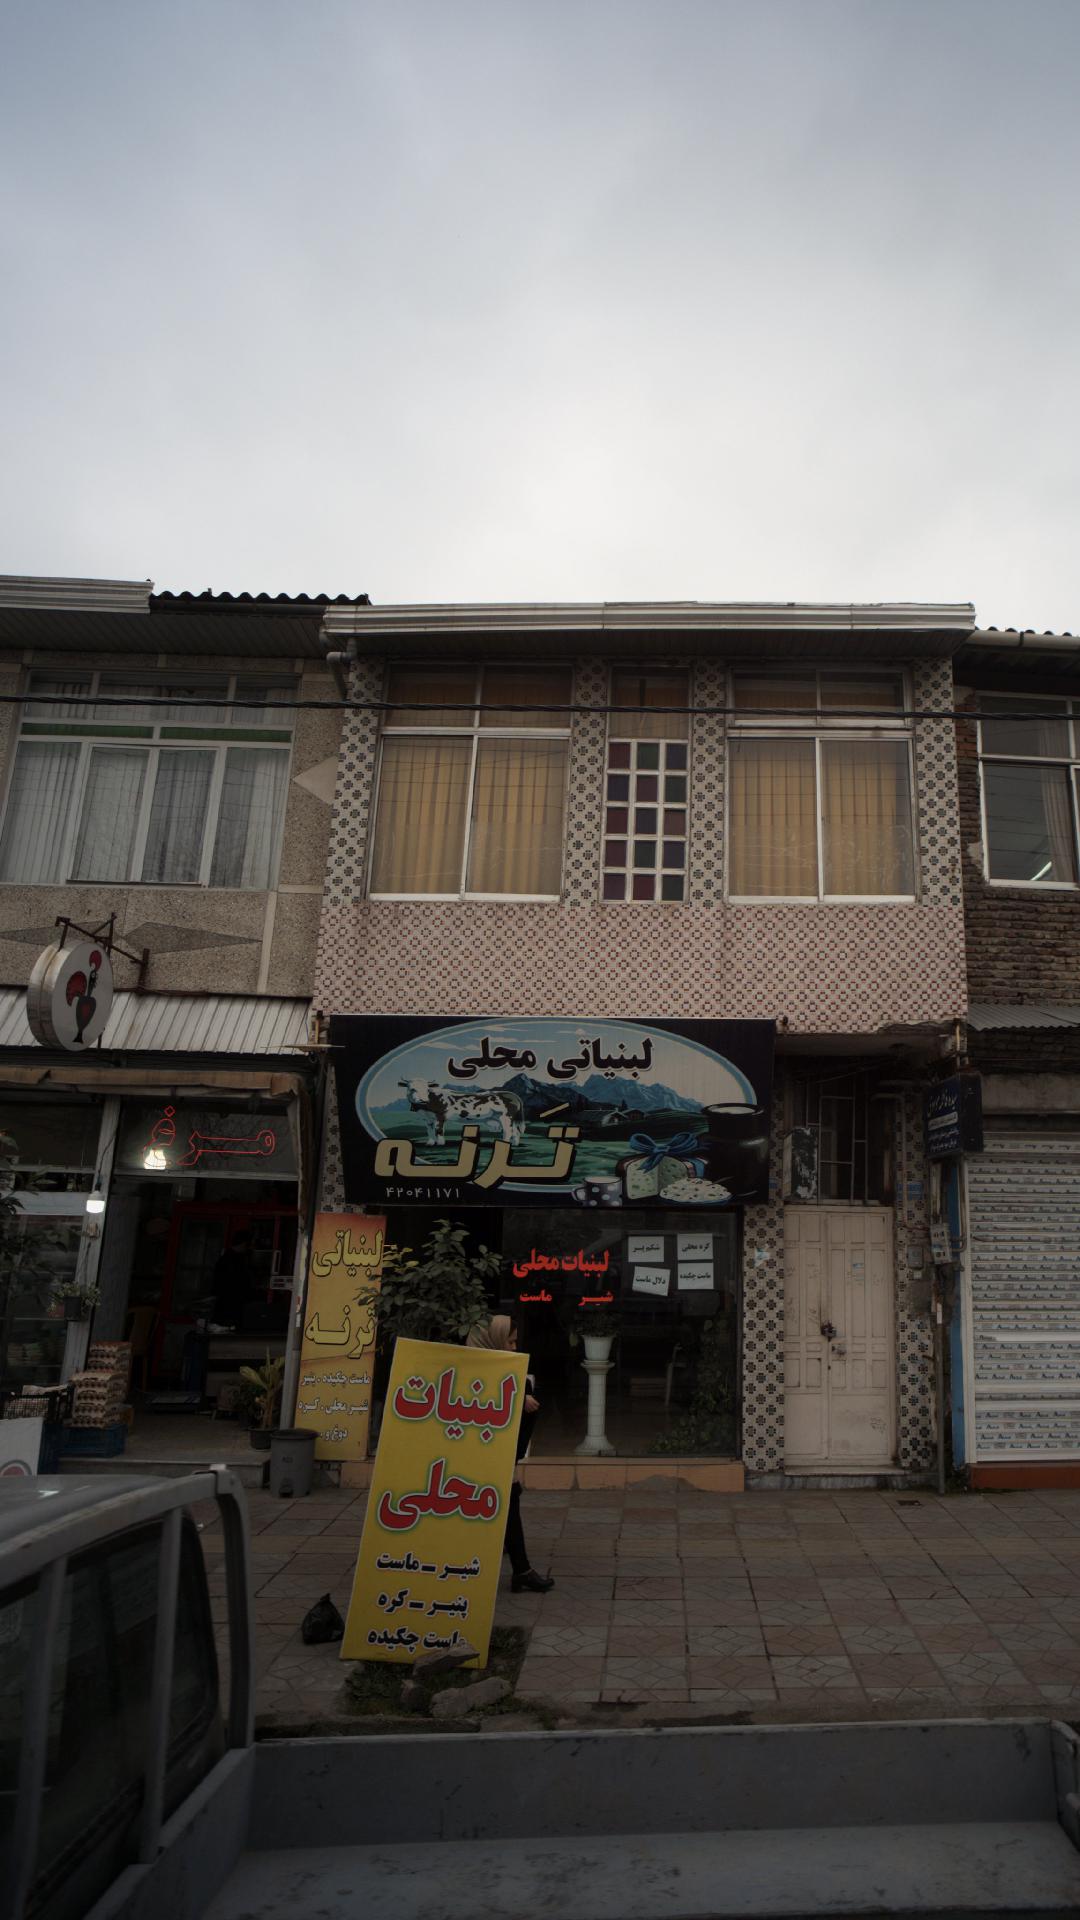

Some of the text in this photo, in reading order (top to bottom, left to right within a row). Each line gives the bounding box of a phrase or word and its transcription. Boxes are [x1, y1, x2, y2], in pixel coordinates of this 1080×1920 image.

[447, 1036, 654, 1080] لبنیاتی محلی
[143, 1105, 276, 1169] مرغ
[311, 1229, 384, 1277] لبنیاتی
[512, 1247, 611, 1279] لبنیات محلی
[518, 1288, 615, 1307] شیر ماست
[304, 1304, 376, 1360] ترنه
[349, 1373, 371, 1385] ماست
[325, 1399, 347, 1414] محلی
[347, 1399, 369, 1416] شیر
[393, 1368, 518, 1442] لبنیات
[378, 1459, 500, 1530] محلی
[375, 1552, 420, 1573] ماست
[438, 1556, 481, 1580] شیر
[377, 1588, 409, 1613] کره
[427, 1596, 469, 1619] پنیر
[367, 1627, 420, 1652] چکیده
